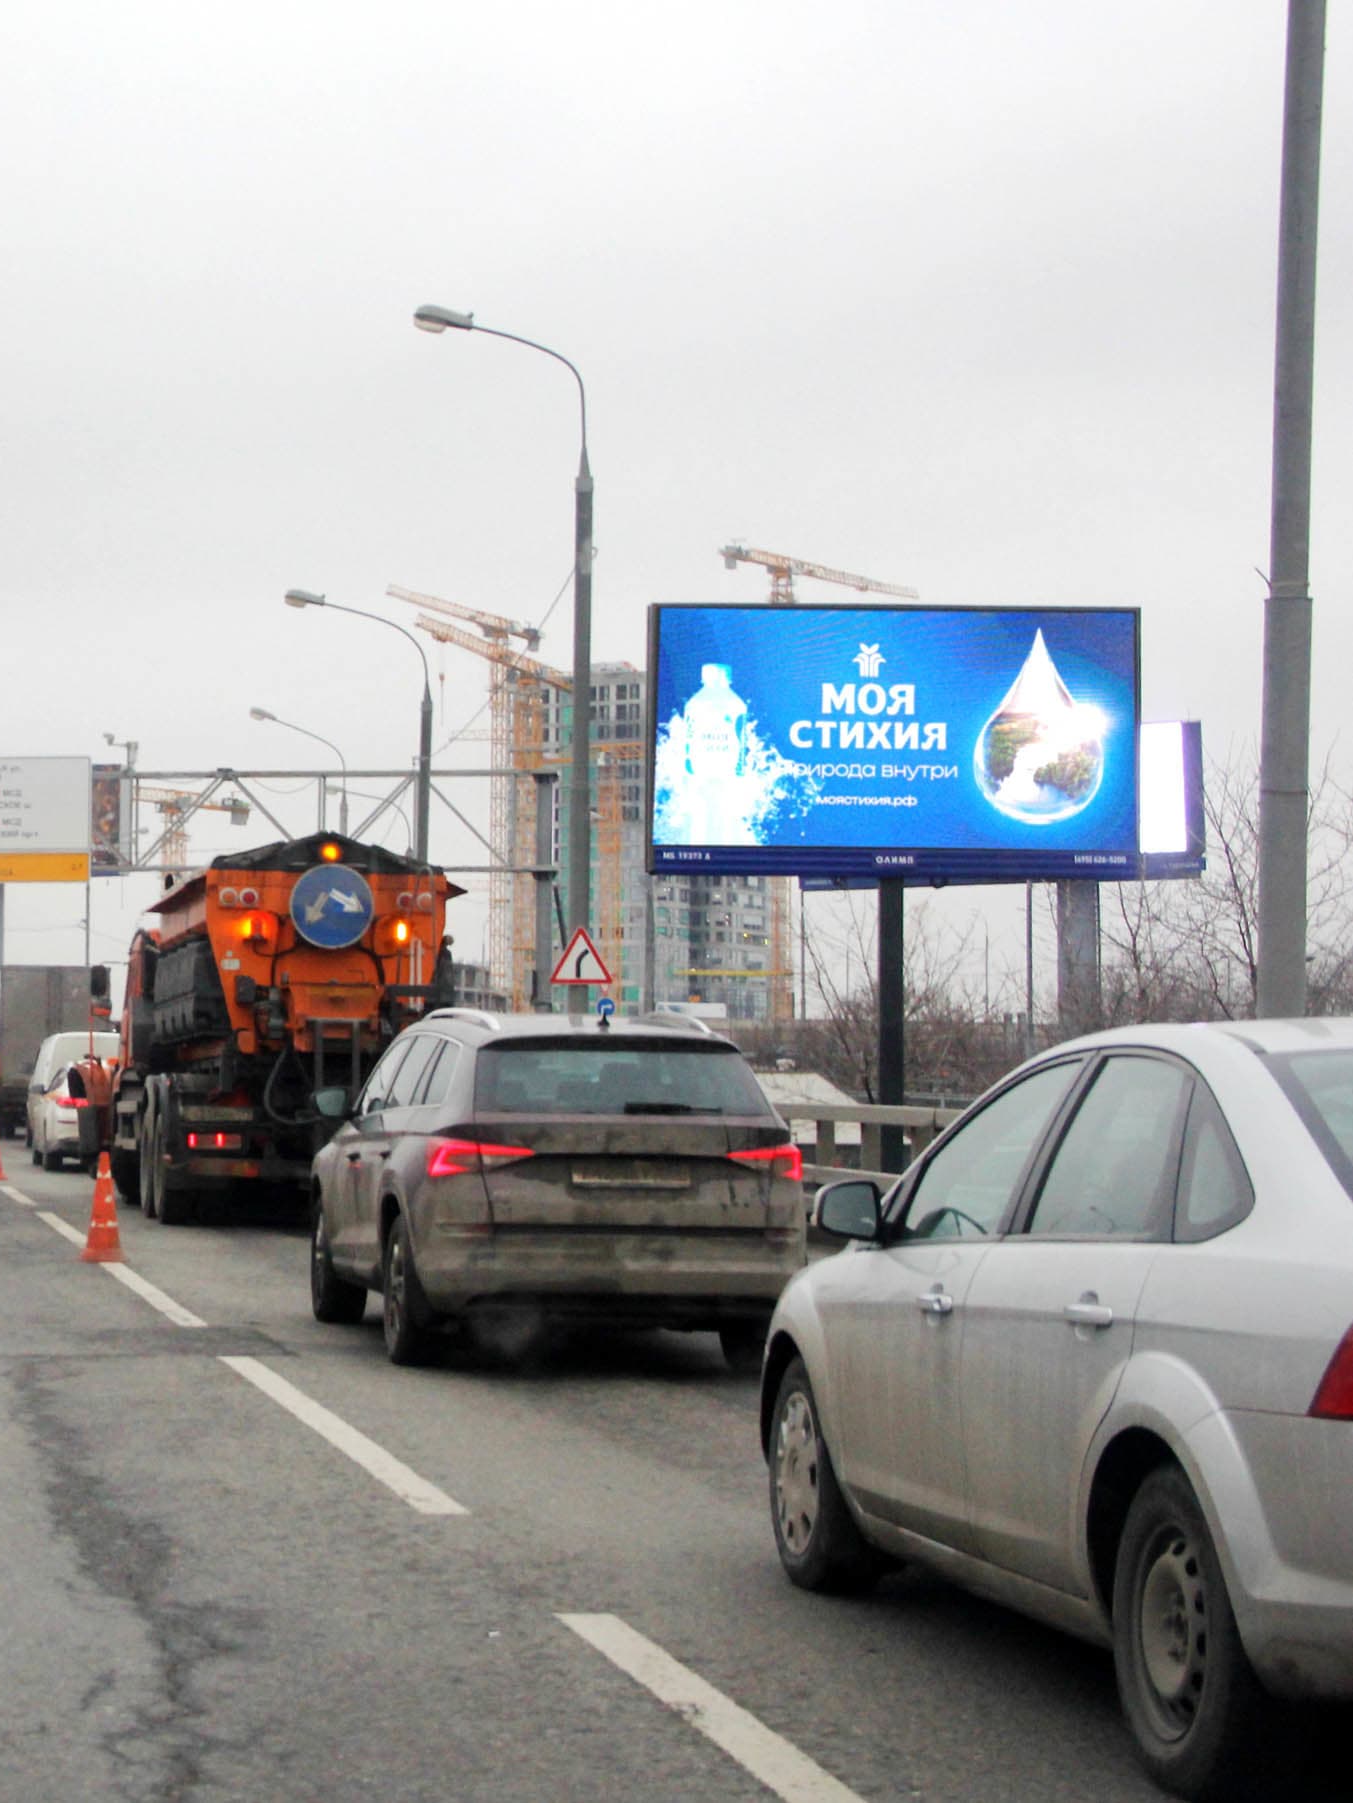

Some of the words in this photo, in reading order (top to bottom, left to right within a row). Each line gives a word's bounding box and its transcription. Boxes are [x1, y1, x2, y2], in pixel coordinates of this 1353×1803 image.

[821, 683, 916, 715] МОЯ
[789, 720, 948, 750] СТИХИЯ
[779, 763, 877, 780] рирода
[881, 764, 959, 781] внутри
[815, 794, 918, 808] моястихия.рф
